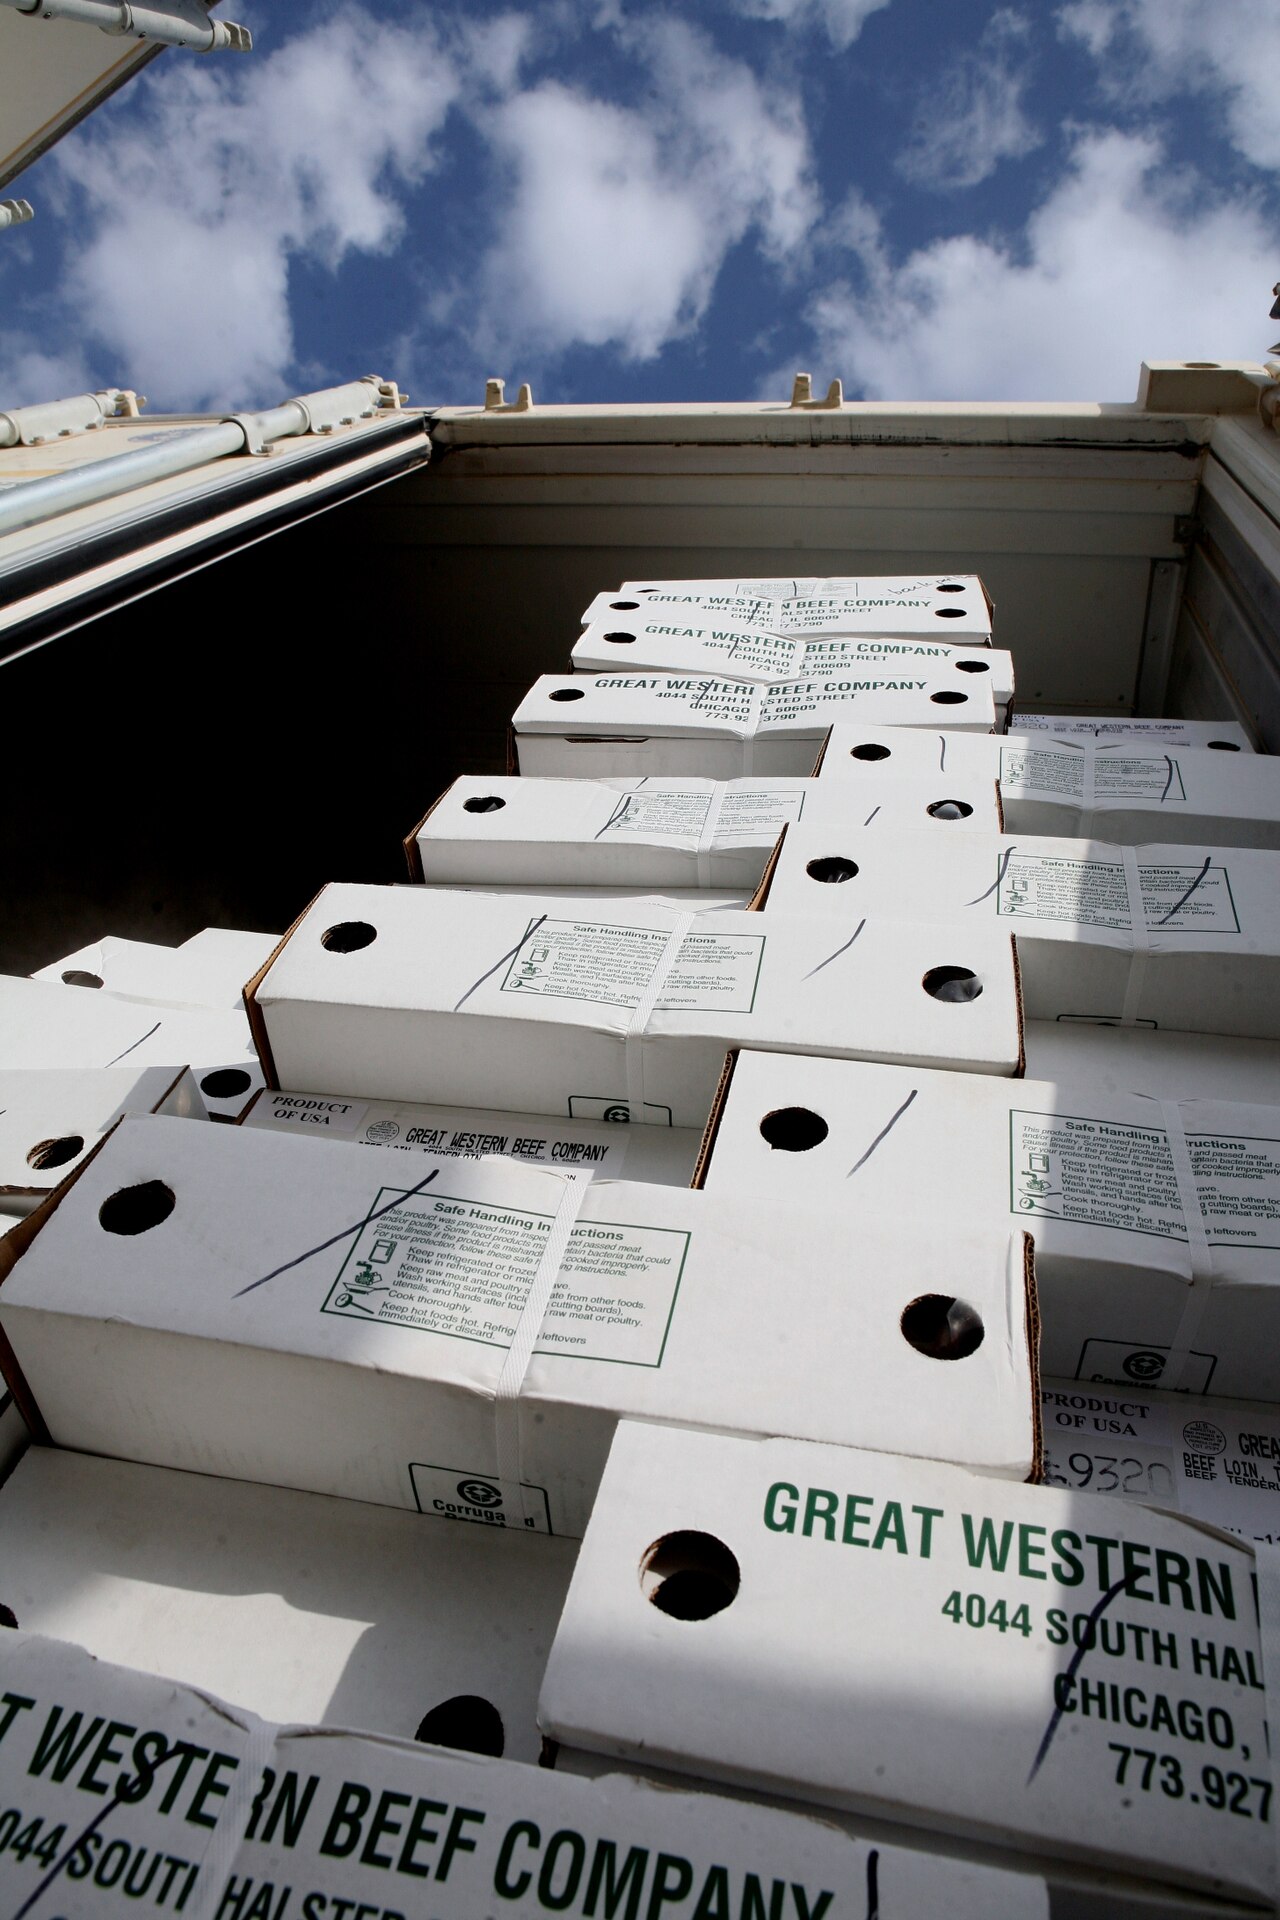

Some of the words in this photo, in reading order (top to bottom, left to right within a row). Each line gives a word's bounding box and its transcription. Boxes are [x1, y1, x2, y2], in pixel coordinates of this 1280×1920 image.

[647, 595, 704, 604] GREAT
[797, 600, 838, 608] BEEF
[844, 600, 932, 608] COMPANY
[731, 606, 770, 616] SOUTH
[781, 608, 826, 616] ALSTED
[645, 625, 706, 638] GREAT
[712, 631, 796, 651] WESTERN
[805, 642, 851, 653] BEEF
[857, 643, 952, 657] COMPANY
[702, 641, 732, 650] 4044
[735, 645, 777, 657] SOUTH
[594, 679, 661, 689] GREAT
[768, 683, 818, 696] BEEF
[824, 681, 928, 692] COMPANY
[656, 692, 687, 700] 4044
[691, 693, 737, 704] SOUTH
[805, 693, 858, 702] STREET
[775, 704, 816, 714] 60609
[1066, 862, 1114, 873] Handling
[1116, 868, 1180, 876] Inuctions
[573, 925, 598, 934] Safe
[600, 928, 648, 940] Handling
[652, 934, 716, 944] Insctions
[272, 1096, 352, 1114] PRODUCT
[274, 1108, 298, 1119] OF
[300, 1112, 330, 1125] USA
[406, 1128, 448, 1146] GREAT
[450, 1132, 509, 1152] WESTERN
[512, 1138, 547, 1156] BEEF
[551, 1142, 610, 1162] COMPANY
[1066, 1122, 1096, 1133] Safe
[1099, 1126, 1160, 1144] Handling
[1163, 1136, 1246, 1150] Iructions
[403, 1210, 437, 1222] product
[456, 1220, 498, 1232] prepared
[499, 1226, 520, 1237] from
[583, 1241, 617, 1251] passed
[618, 1244, 642, 1254] meat
[434, 1202, 466, 1216] Safe
[469, 1208, 534, 1230] Handling
[537, 1222, 624, 1240] Inuctions
[373, 1228, 390, 1238] For
[388, 1232, 411, 1241] your
[458, 1244, 486, 1254] follow
[486, 1250, 512, 1260] these
[513, 1255, 534, 1264] safe
[376, 1222, 404, 1232] cause
[404, 1226, 432, 1236] illness
[441, 1232, 456, 1240] the
[456, 1236, 492, 1248] product
[566, 1256, 599, 1266] cooked
[380, 1215, 408, 1224] and/or
[444, 1225, 470, 1235] Some
[472, 1230, 492, 1240] food
[492, 1235, 532, 1247] products
[587, 1249, 624, 1260] bacteria
[626, 1253, 644, 1262] that
[644, 1256, 672, 1265] could
[406, 1253, 433, 1265] Thaw
[446, 1262, 501, 1278] refrigerator
[408, 1246, 434, 1258] Keep
[436, 1252, 494, 1268] refrigerated
[388, 1290, 416, 1302] Cook
[397, 1270, 423, 1282] Wash
[426, 1277, 461, 1290] working
[462, 1284, 502, 1298] surfaces
[550, 1301, 582, 1312] cutting
[400, 1262, 424, 1274] Keep
[426, 1268, 444, 1277] raw
[445, 1272, 469, 1282] meat
[470, 1277, 490, 1286] and
[490, 1281, 522, 1294] poultry
[566, 1292, 588, 1302] from
[590, 1296, 615, 1306] other
[378, 1308, 440, 1328] immediately
[452, 1289, 482, 1302] hands
[484, 1298, 506, 1308] after
[548, 1309, 567, 1317] raw
[569, 1312, 594, 1320] meat
[382, 1300, 408, 1314] Keep
[410, 1306, 428, 1316] hot
[430, 1310, 458, 1323] foods
[542, 1332, 587, 1344] leftovers
[1041, 1391, 1150, 1419] PRODUCT
[1055, 1412, 1087, 1428] OF
[1094, 1418, 1138, 1437] USA
[1183, 1452, 1216, 1472] BEEF
[1185, 1468, 1218, 1480] BEEF
[433, 1499, 535, 1528] Corrugad
[763, 1481, 944, 1559] GREAT
[962, 1512, 1237, 1621] WESTERN
[942, 1590, 1033, 1638] 4044
[1046, 1608, 1180, 1670] SOUTH
[1052, 1672, 1250, 1762] CHICAGO,
[1108, 1741, 1274, 1824] 773.927
[319, 1781, 486, 1882] BEEF
[493, 1819, 835, 1920] COMPANY
